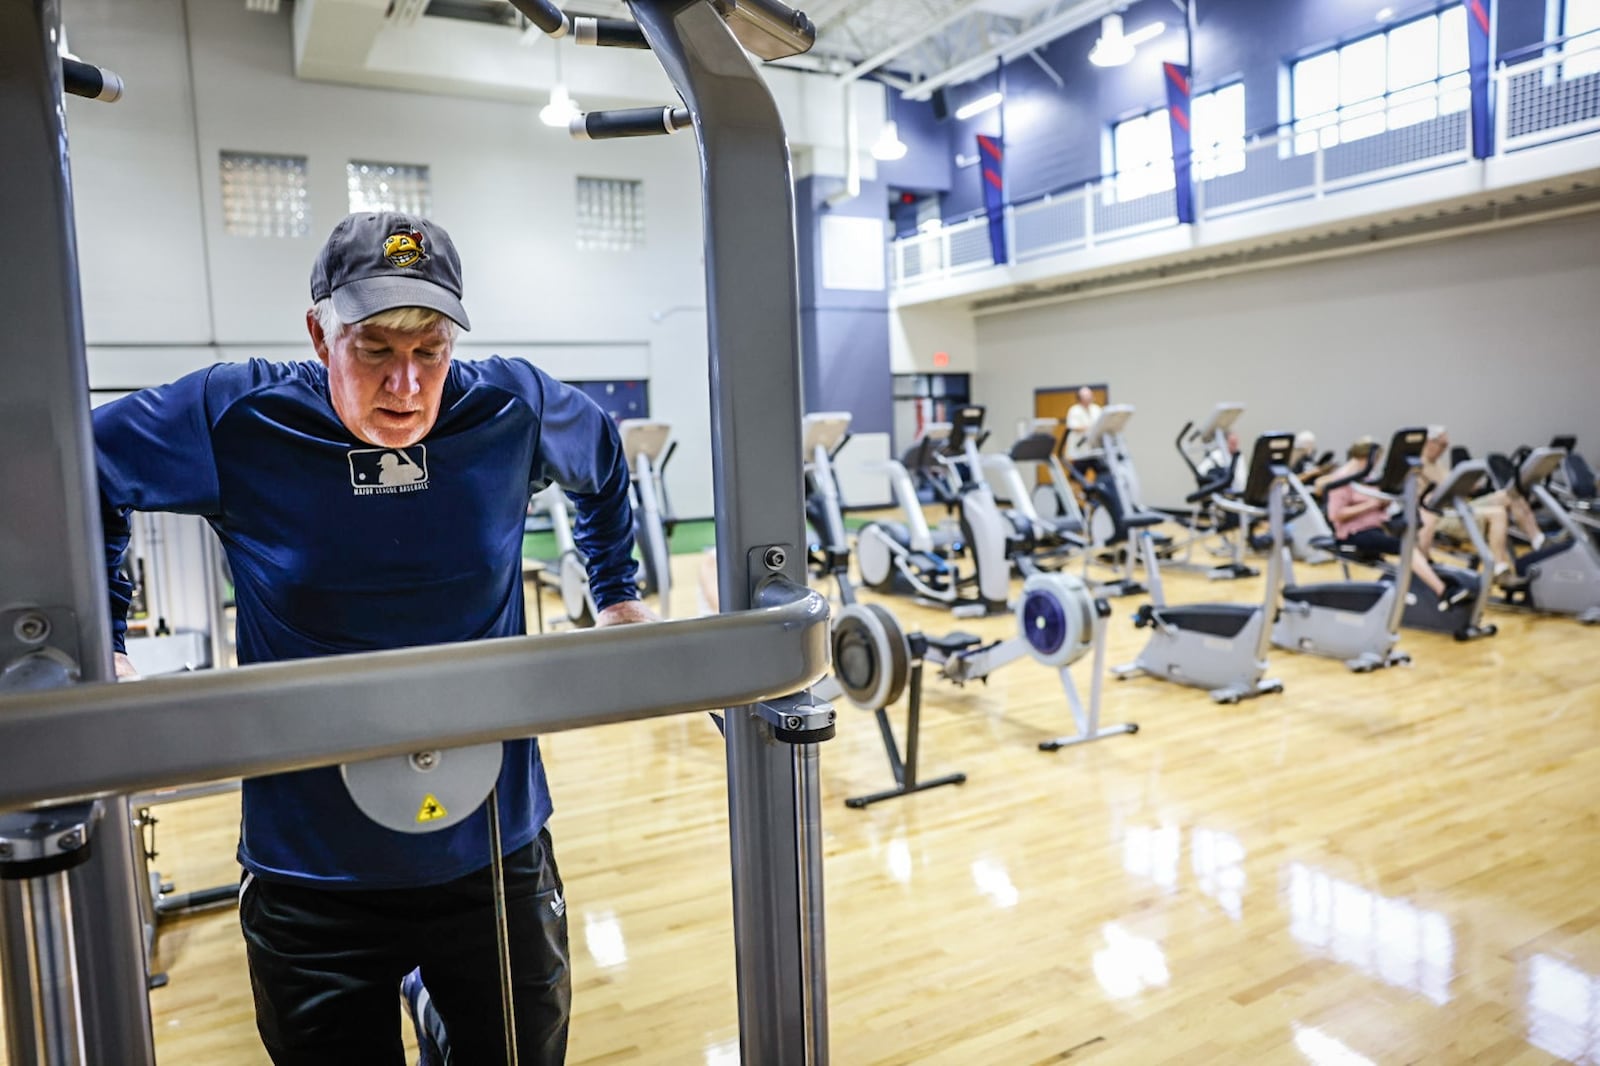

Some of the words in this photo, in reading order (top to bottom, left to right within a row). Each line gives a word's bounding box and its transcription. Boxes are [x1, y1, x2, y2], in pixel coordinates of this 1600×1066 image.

[353, 487, 373, 495] MAJOR
[375, 486, 398, 494] LEAGUE
[400, 482, 428, 492] BASEBALL
